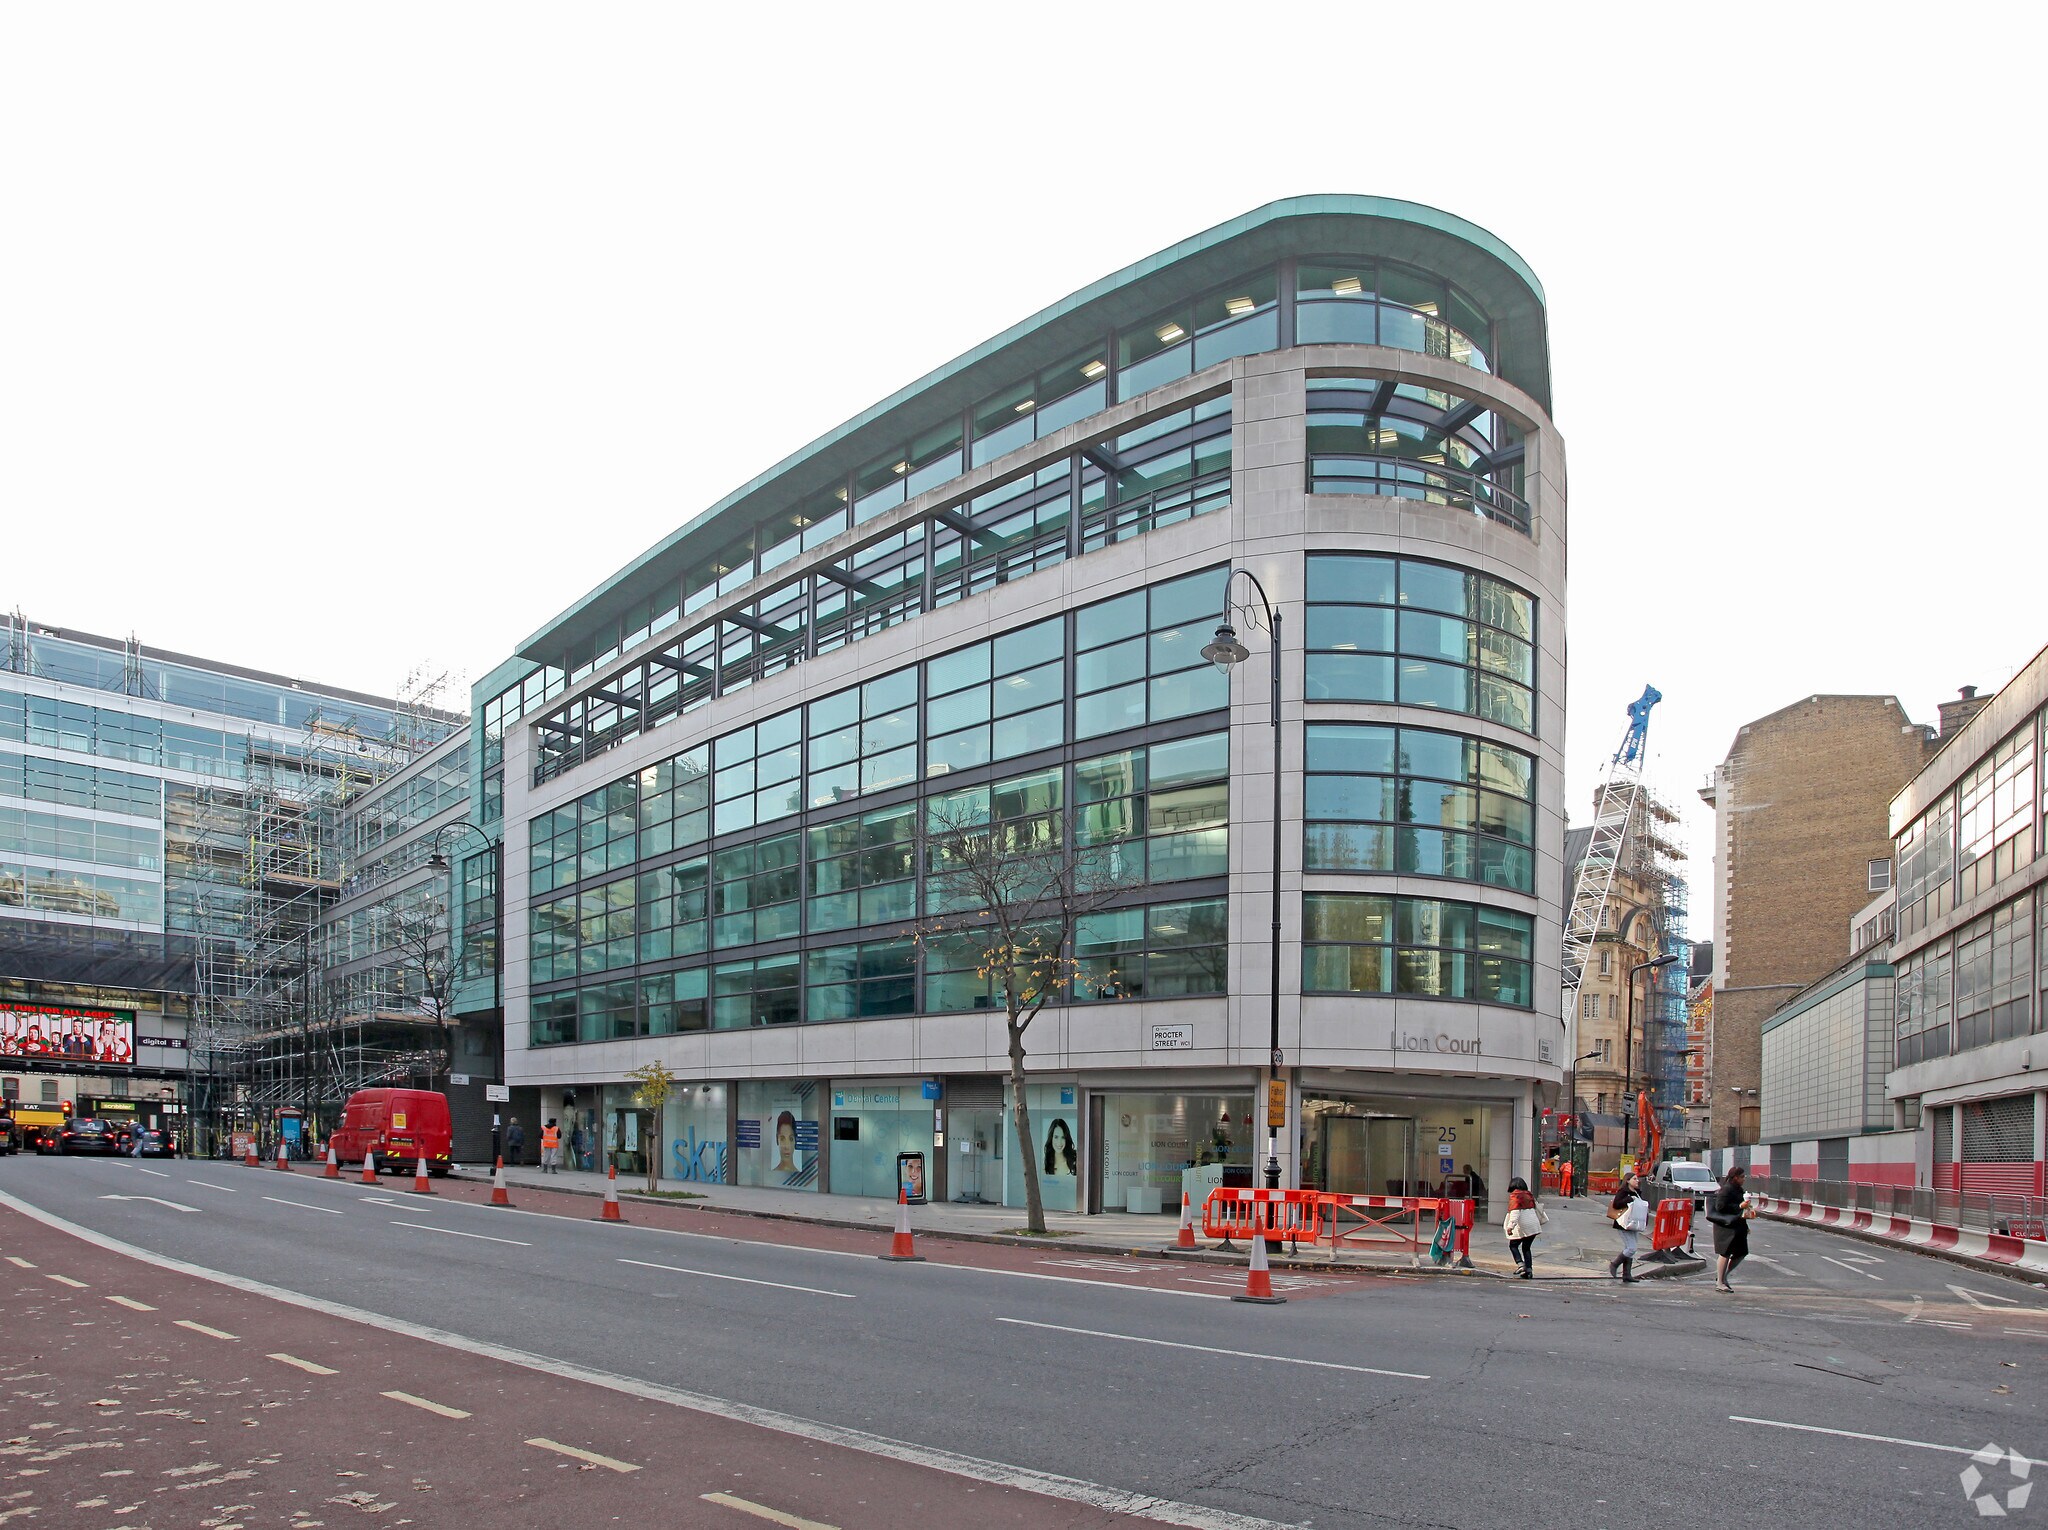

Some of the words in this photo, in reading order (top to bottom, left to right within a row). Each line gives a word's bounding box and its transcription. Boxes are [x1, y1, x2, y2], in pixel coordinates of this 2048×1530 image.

[14, 1004, 37, 1013] FUN
[39, 1006, 60, 1014] FOR
[1154, 1031, 1183, 1039] PROCTER
[142, 1038, 167, 1047] digital
[1391, 1031, 1430, 1051] Lion
[1435, 1033, 1482, 1055] Court
[1274, 1053, 1282, 1062] 20
[848, 1094, 871, 1103] Dental
[874, 1094, 899, 1104] Centre
[1438, 1126, 1457, 1142] 25
